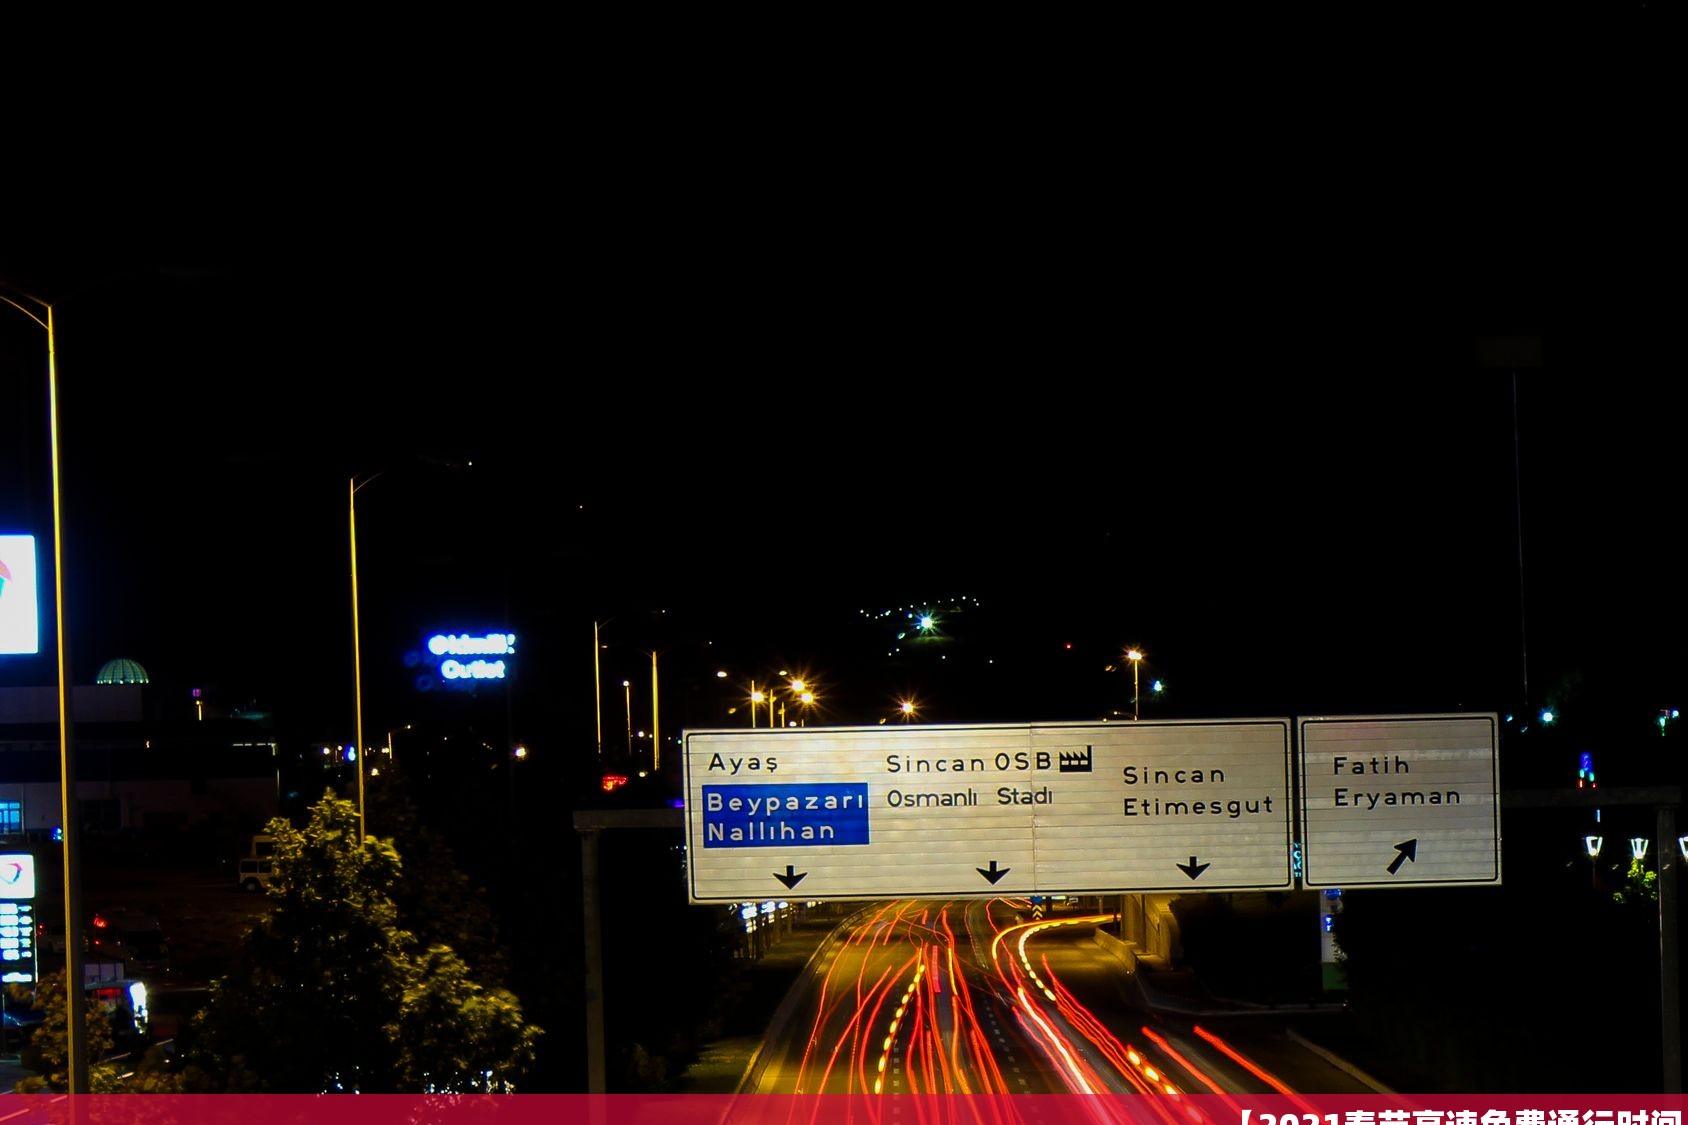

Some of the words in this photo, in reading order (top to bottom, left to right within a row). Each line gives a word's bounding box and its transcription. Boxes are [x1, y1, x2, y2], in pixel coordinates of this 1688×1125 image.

[708, 752, 779, 775] Ayaş
[886, 754, 985, 773] Sincan
[994, 751, 1052, 772] OSB
[1333, 755, 1410, 776] Fatih
[1122, 766, 1226, 785] Sincan
[706, 792, 864, 816] Beypazarı
[887, 787, 978, 809] Osmanlı
[997, 786, 1053, 806] Stadı
[1123, 796, 1274, 819] Etimesgut
[1334, 787, 1461, 811] Eryaman
[707, 822, 835, 842] Nallıhan
